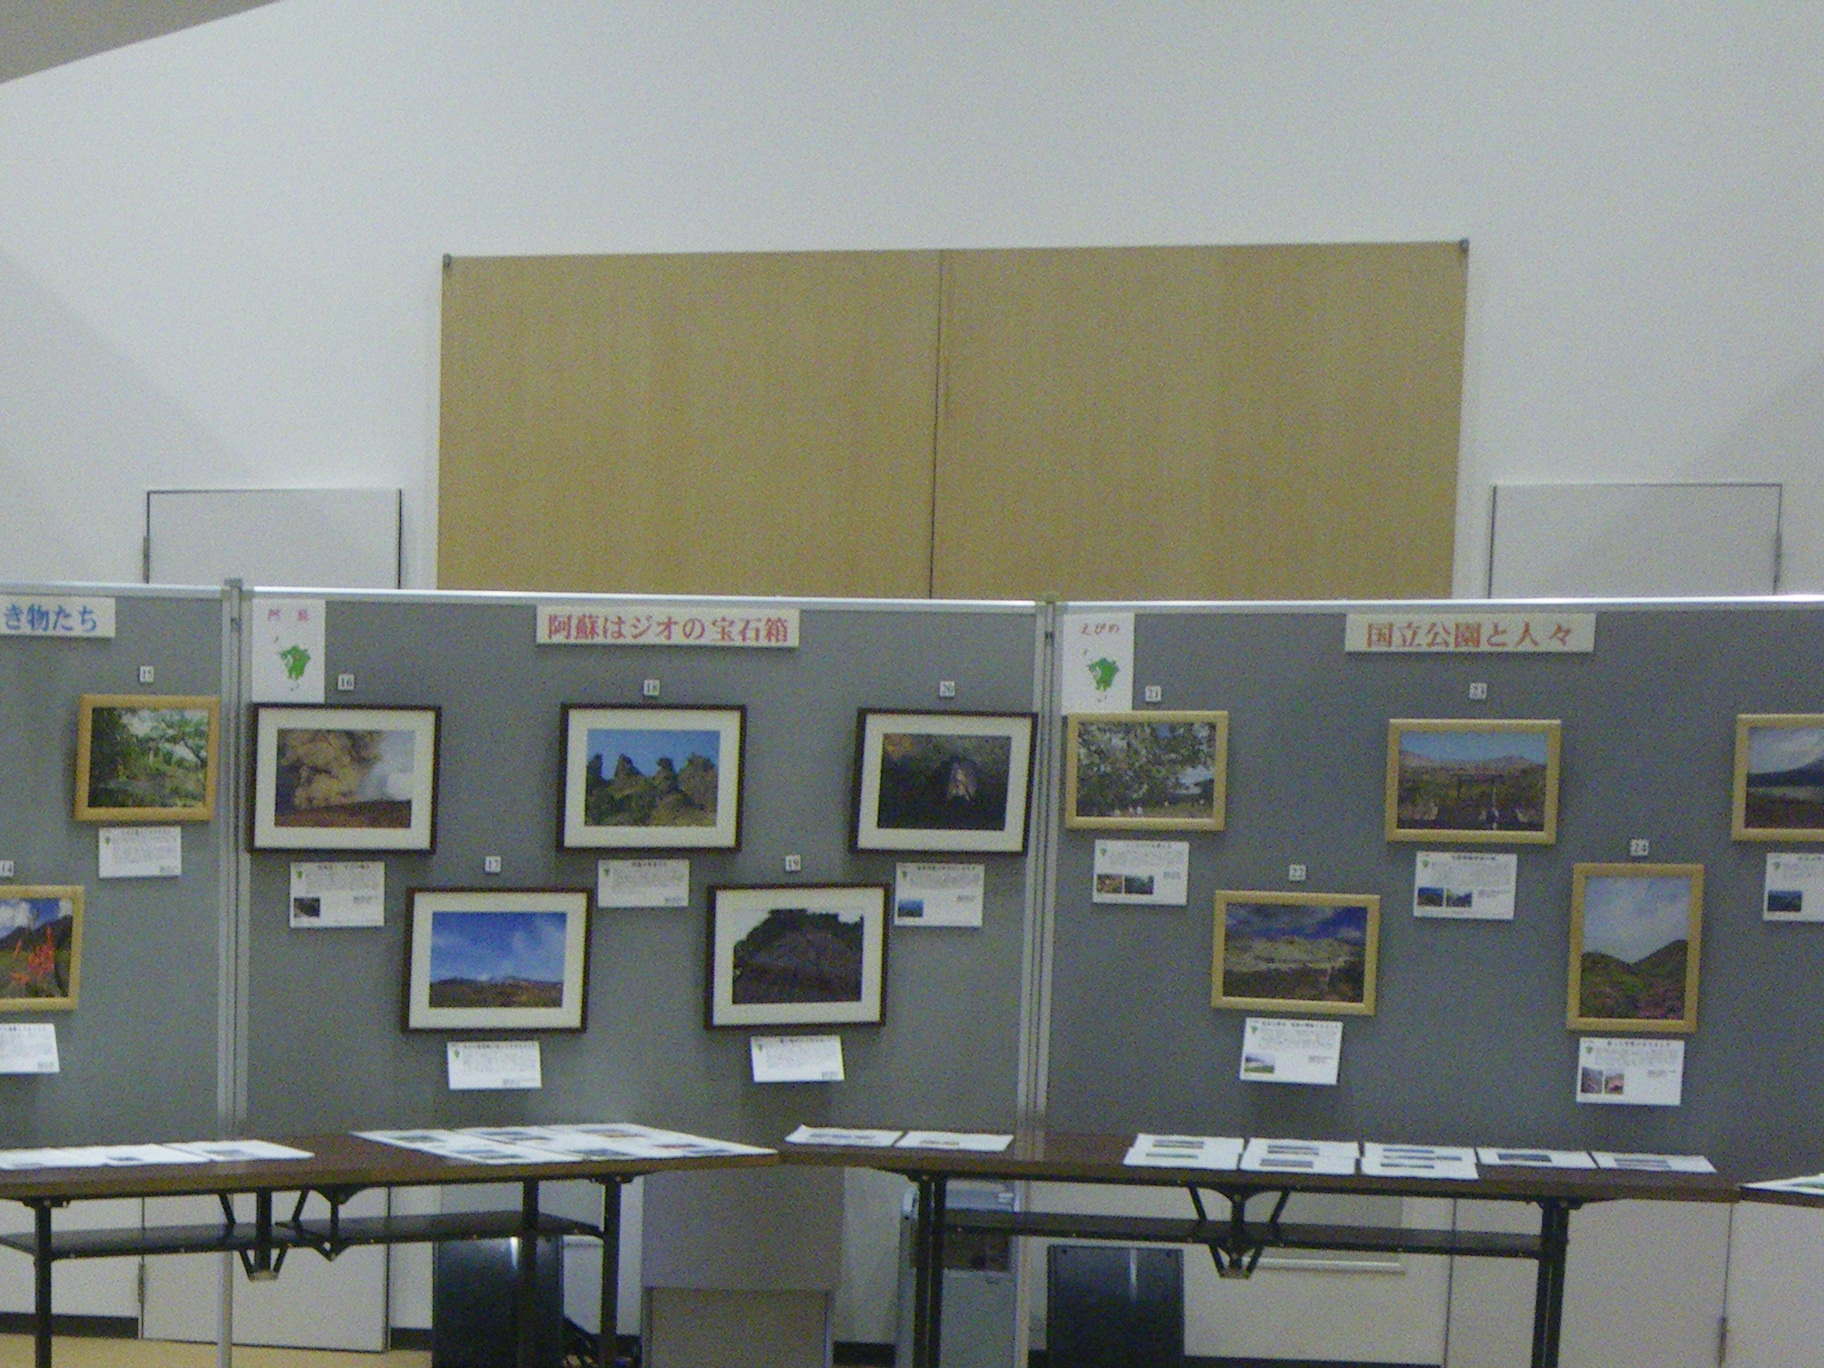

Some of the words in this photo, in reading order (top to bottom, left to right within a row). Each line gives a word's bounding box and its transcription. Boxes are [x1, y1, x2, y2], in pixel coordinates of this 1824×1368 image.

[547, 613, 789, 643] 阿蘇はジオの宝石箱
[1367, 621, 1573, 648] 国立公園と人々
